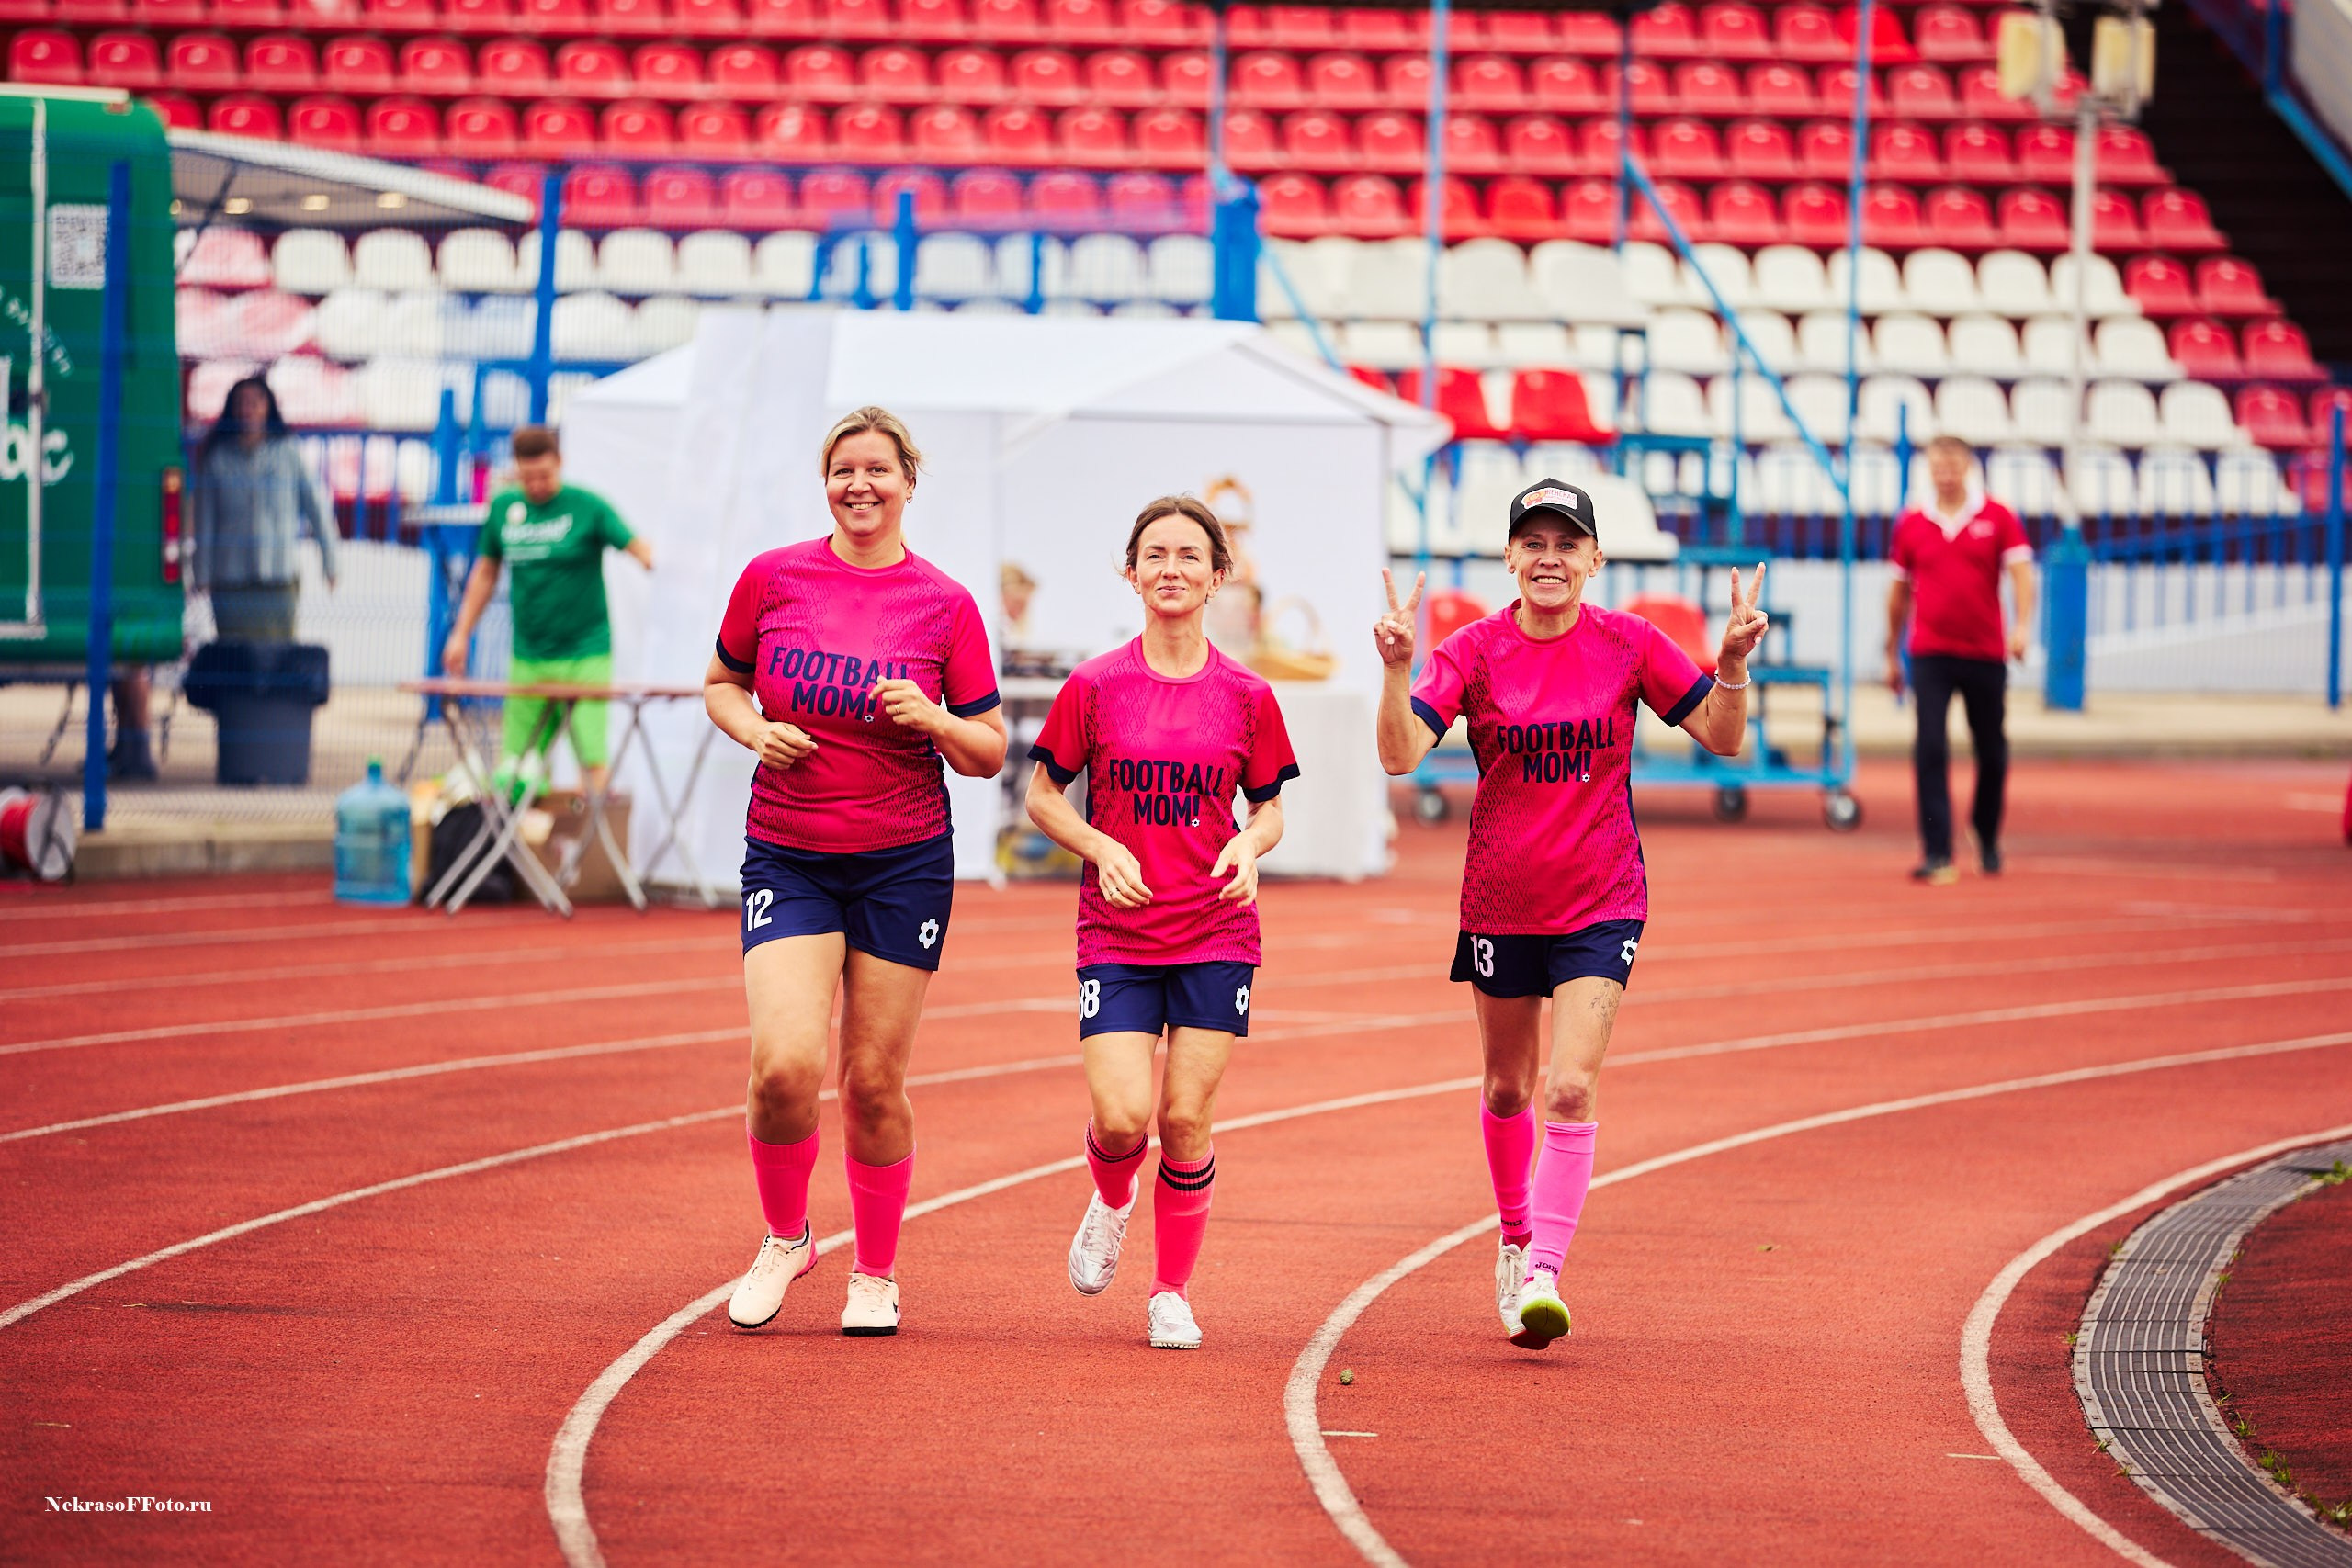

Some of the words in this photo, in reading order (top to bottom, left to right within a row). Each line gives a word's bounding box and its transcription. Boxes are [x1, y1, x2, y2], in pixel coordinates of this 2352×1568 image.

[1498, 717, 1614, 753] FOOTBALL
[1109, 758, 1224, 797] FOOTBALL
[1523, 750, 1591, 783] MOM!
[1134, 793, 1200, 827] MOM!
[746, 888, 774, 931] 12
[1470, 934, 1495, 977] 13
